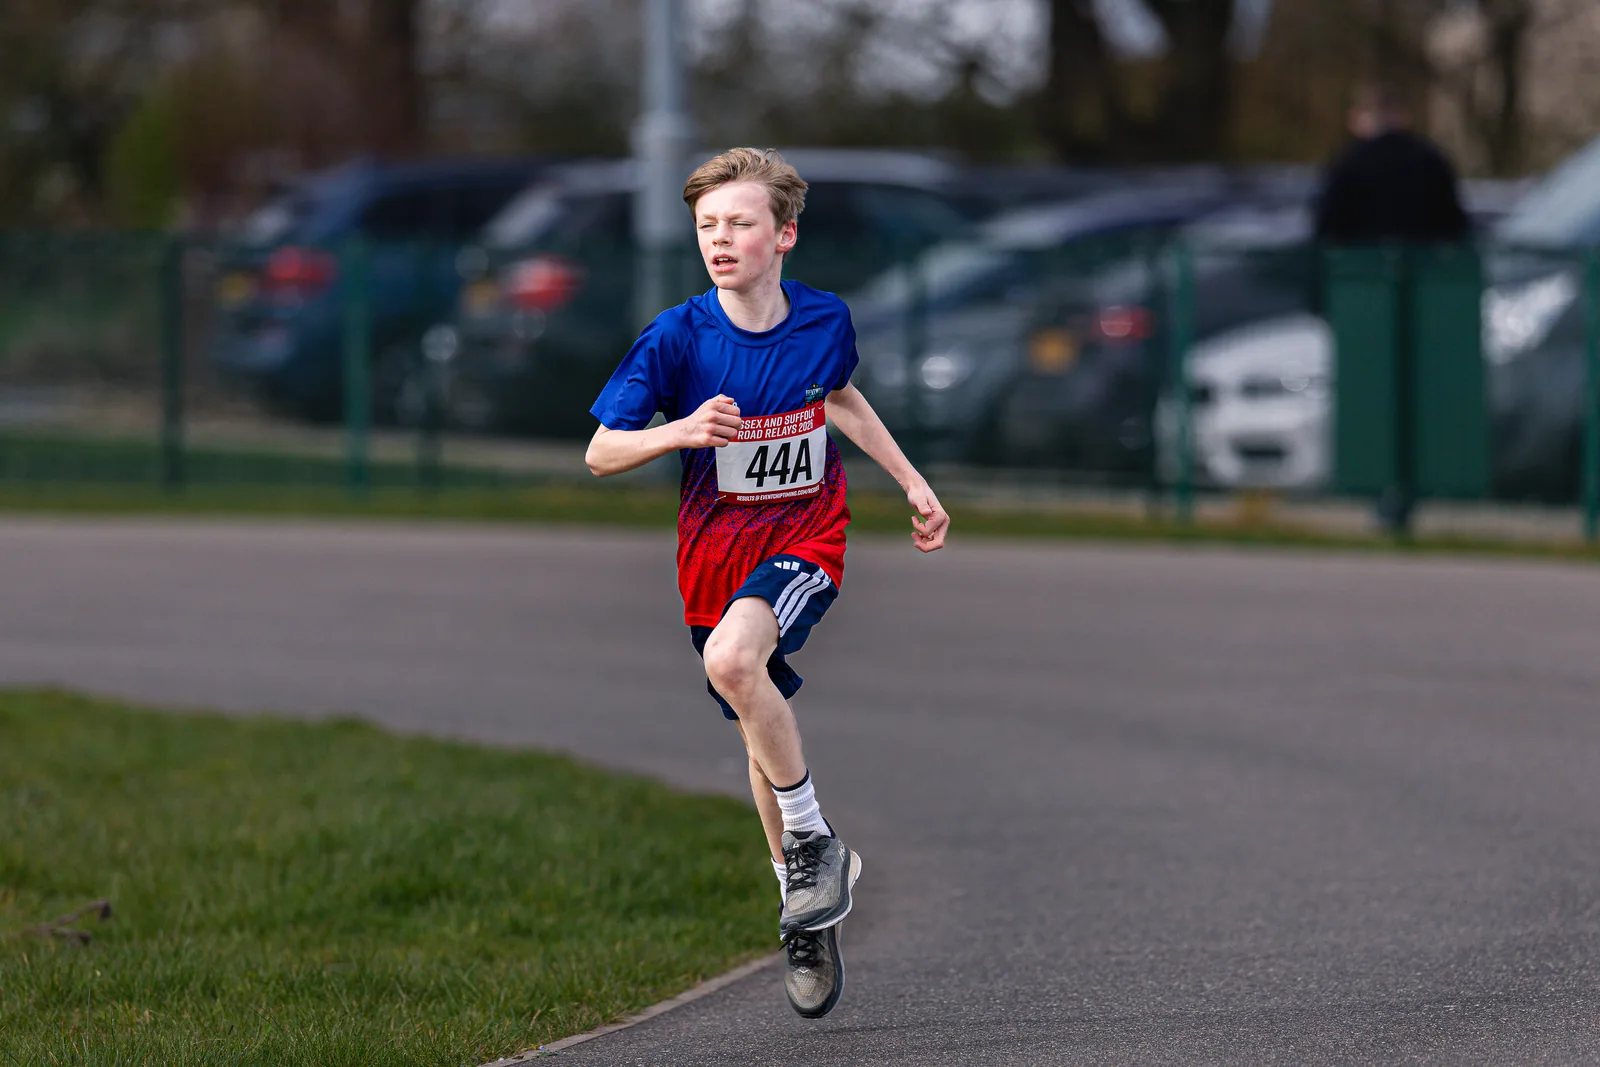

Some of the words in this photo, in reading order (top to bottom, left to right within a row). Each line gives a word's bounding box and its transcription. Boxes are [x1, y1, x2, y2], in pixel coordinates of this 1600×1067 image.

[741, 418, 763, 430] SSEX
[764, 416, 783, 428] AND
[784, 407, 815, 425] SUFFOLK
[737, 429, 763, 440] ROAD
[765, 426, 797, 439] RELAYS
[745, 438, 812, 487] 44A
